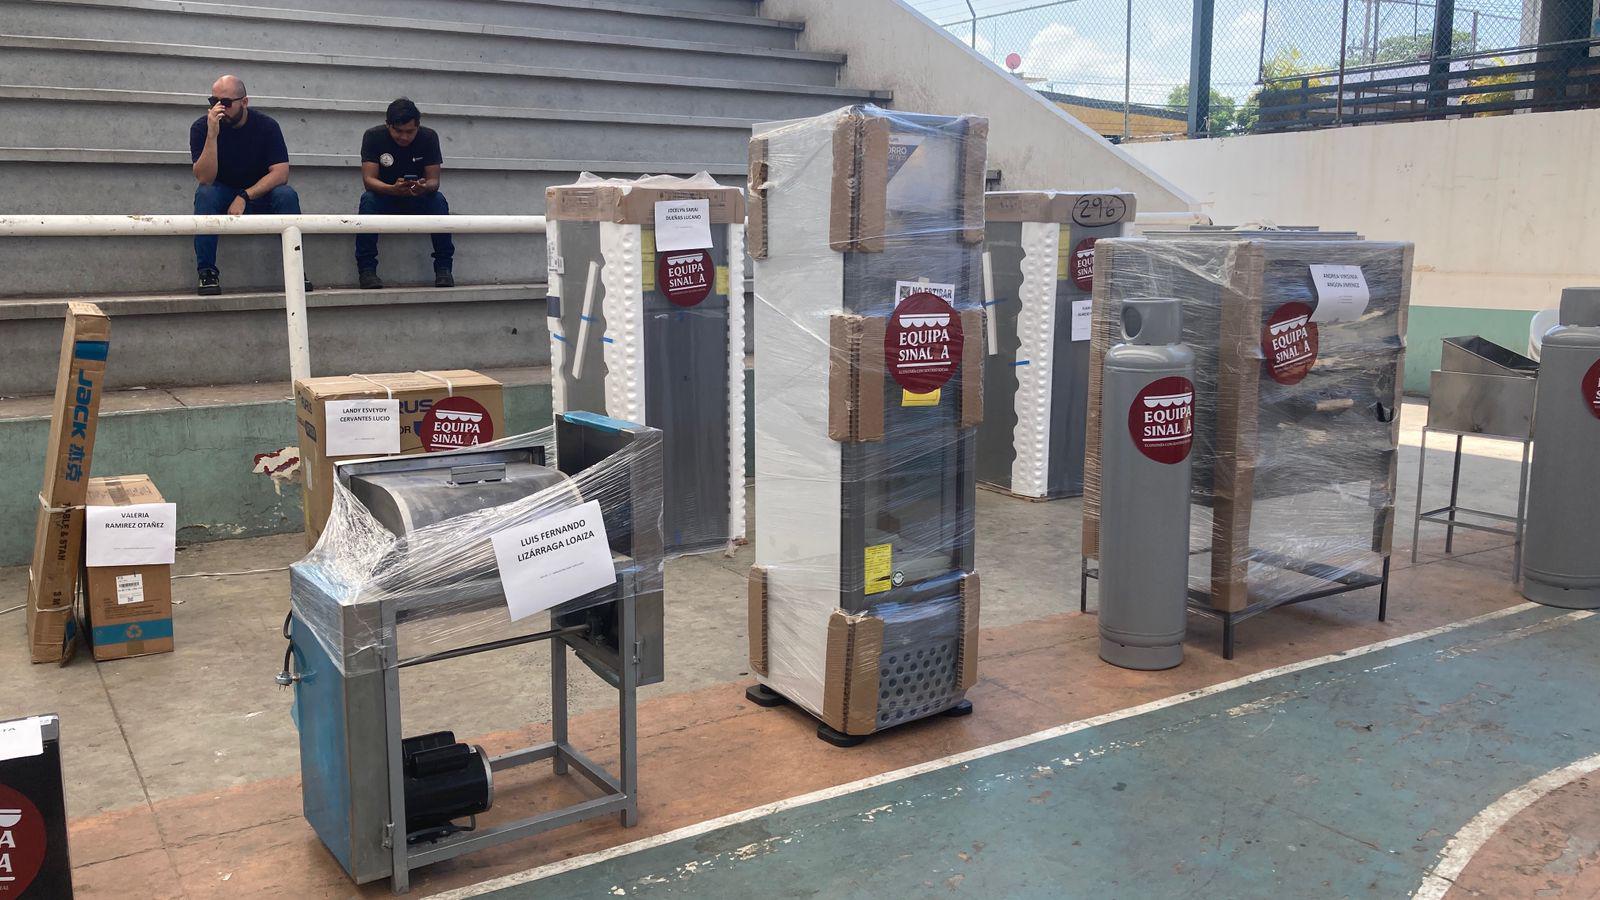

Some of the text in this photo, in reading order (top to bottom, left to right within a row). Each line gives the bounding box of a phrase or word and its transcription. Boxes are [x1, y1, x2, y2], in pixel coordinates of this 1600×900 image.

[668, 263, 705, 277] EQUIPA
[1077, 258, 1093, 268] EQU
[669, 273, 706, 288] SINALA
[1077, 267, 1093, 277] SINA
[899, 328, 950, 346] EQUIPA
[1272, 327, 1308, 351] EQUIPA
[898, 345, 950, 362] SINALA
[1275, 341, 1311, 364] SINALA
[339, 415, 372, 423] CERVANTES
[1144, 405, 1192, 424] EQUIPA
[433, 421, 480, 434] EQUIPA
[1144, 419, 1192, 437] SINALA
[431, 433, 479, 446] SINALA
[105, 520, 164, 529] RAMIREZ OTAÑEZ
[520, 519, 586, 547] LUIS FERNANDO
[57, 538, 68, 565] STAN
[517, 530, 595, 562] LIZÁRRAGA LOAIZA
